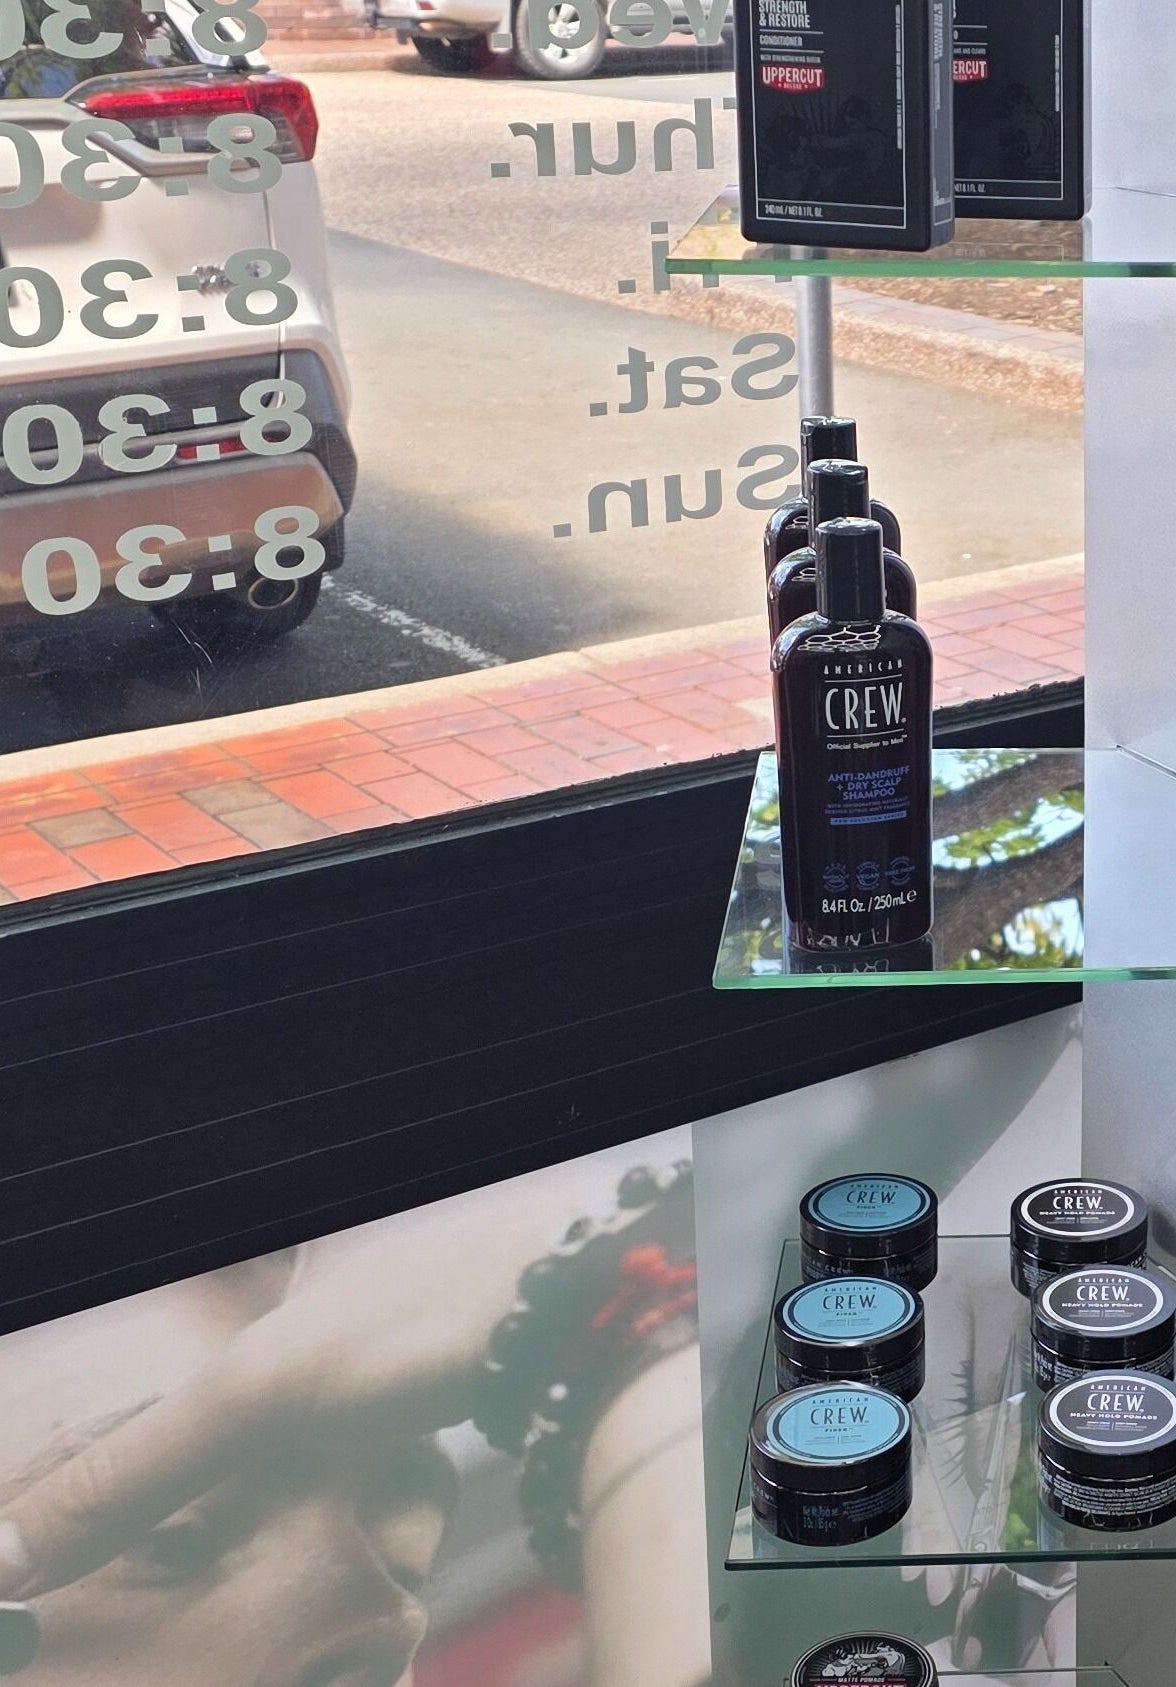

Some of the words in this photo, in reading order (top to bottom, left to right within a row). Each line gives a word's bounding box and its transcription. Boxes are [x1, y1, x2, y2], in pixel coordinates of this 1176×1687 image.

[758, 0, 807, 14] STRENGTH
[758, 13, 767, 27] &
[768, 13, 811, 28] RESTORE
[762, 66, 823, 87] UPPERCUT
[952, 60, 987, 78] ERCUT
[824, 658, 903, 675] AMERICAN
[827, 765, 910, 783] ANTI-DANDRUFF
[847, 780, 871, 791] DRY
[871, 777, 902, 789] SCALP
[842, 787, 896, 801] SHAMPOO
